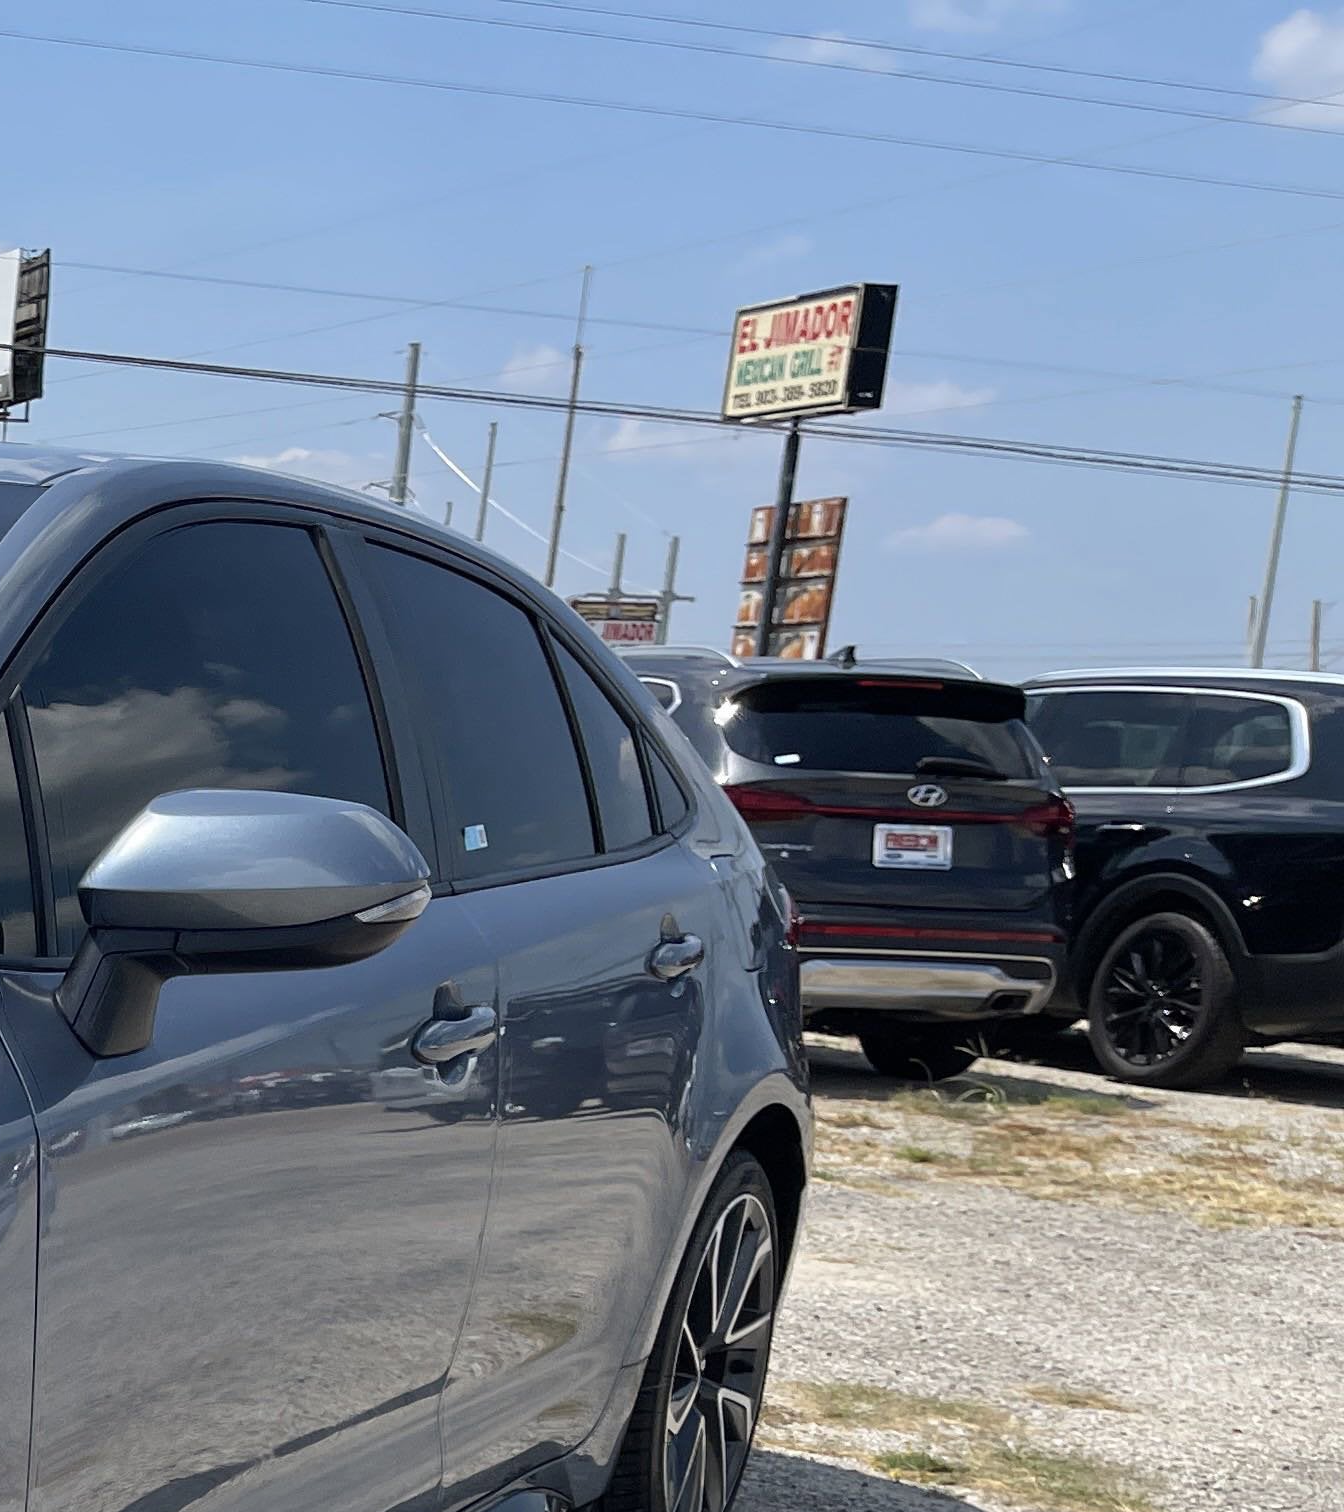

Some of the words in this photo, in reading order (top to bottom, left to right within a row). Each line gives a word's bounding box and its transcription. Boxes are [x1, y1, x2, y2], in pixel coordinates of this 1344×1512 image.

[736, 318, 758, 354] EL
[763, 300, 853, 348] JIMADOR
[735, 354, 787, 388] MEXICAN
[791, 348, 823, 378] GRILL
